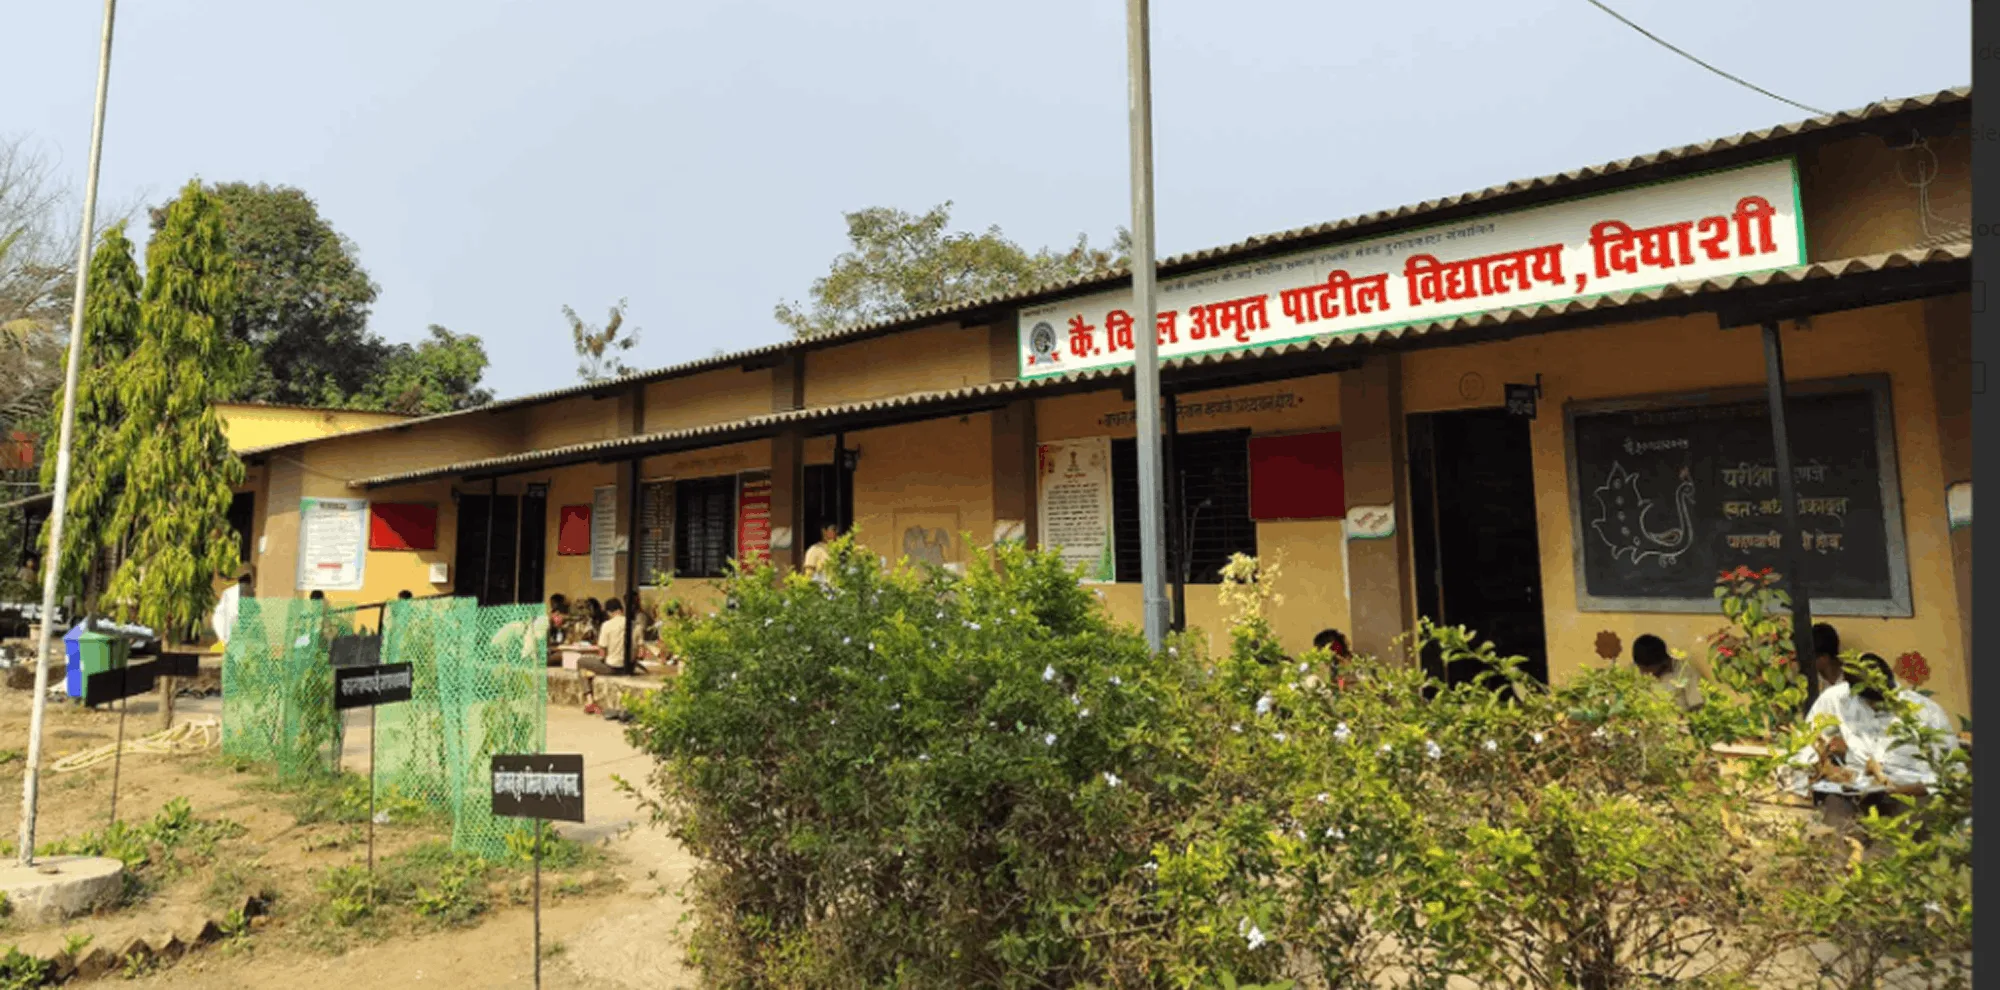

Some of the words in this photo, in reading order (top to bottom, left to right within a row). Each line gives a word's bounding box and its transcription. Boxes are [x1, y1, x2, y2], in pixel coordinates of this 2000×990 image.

[1068, 313, 1100, 358] कै.
[1105, 309, 1178, 353] विल
[1189, 294, 1270, 343] अमृत
[1280, 269, 1391, 324] पाटील
[1588, 195, 1778, 278] दिघाशी
[1721, 461, 1777, 493] परीक्षा
